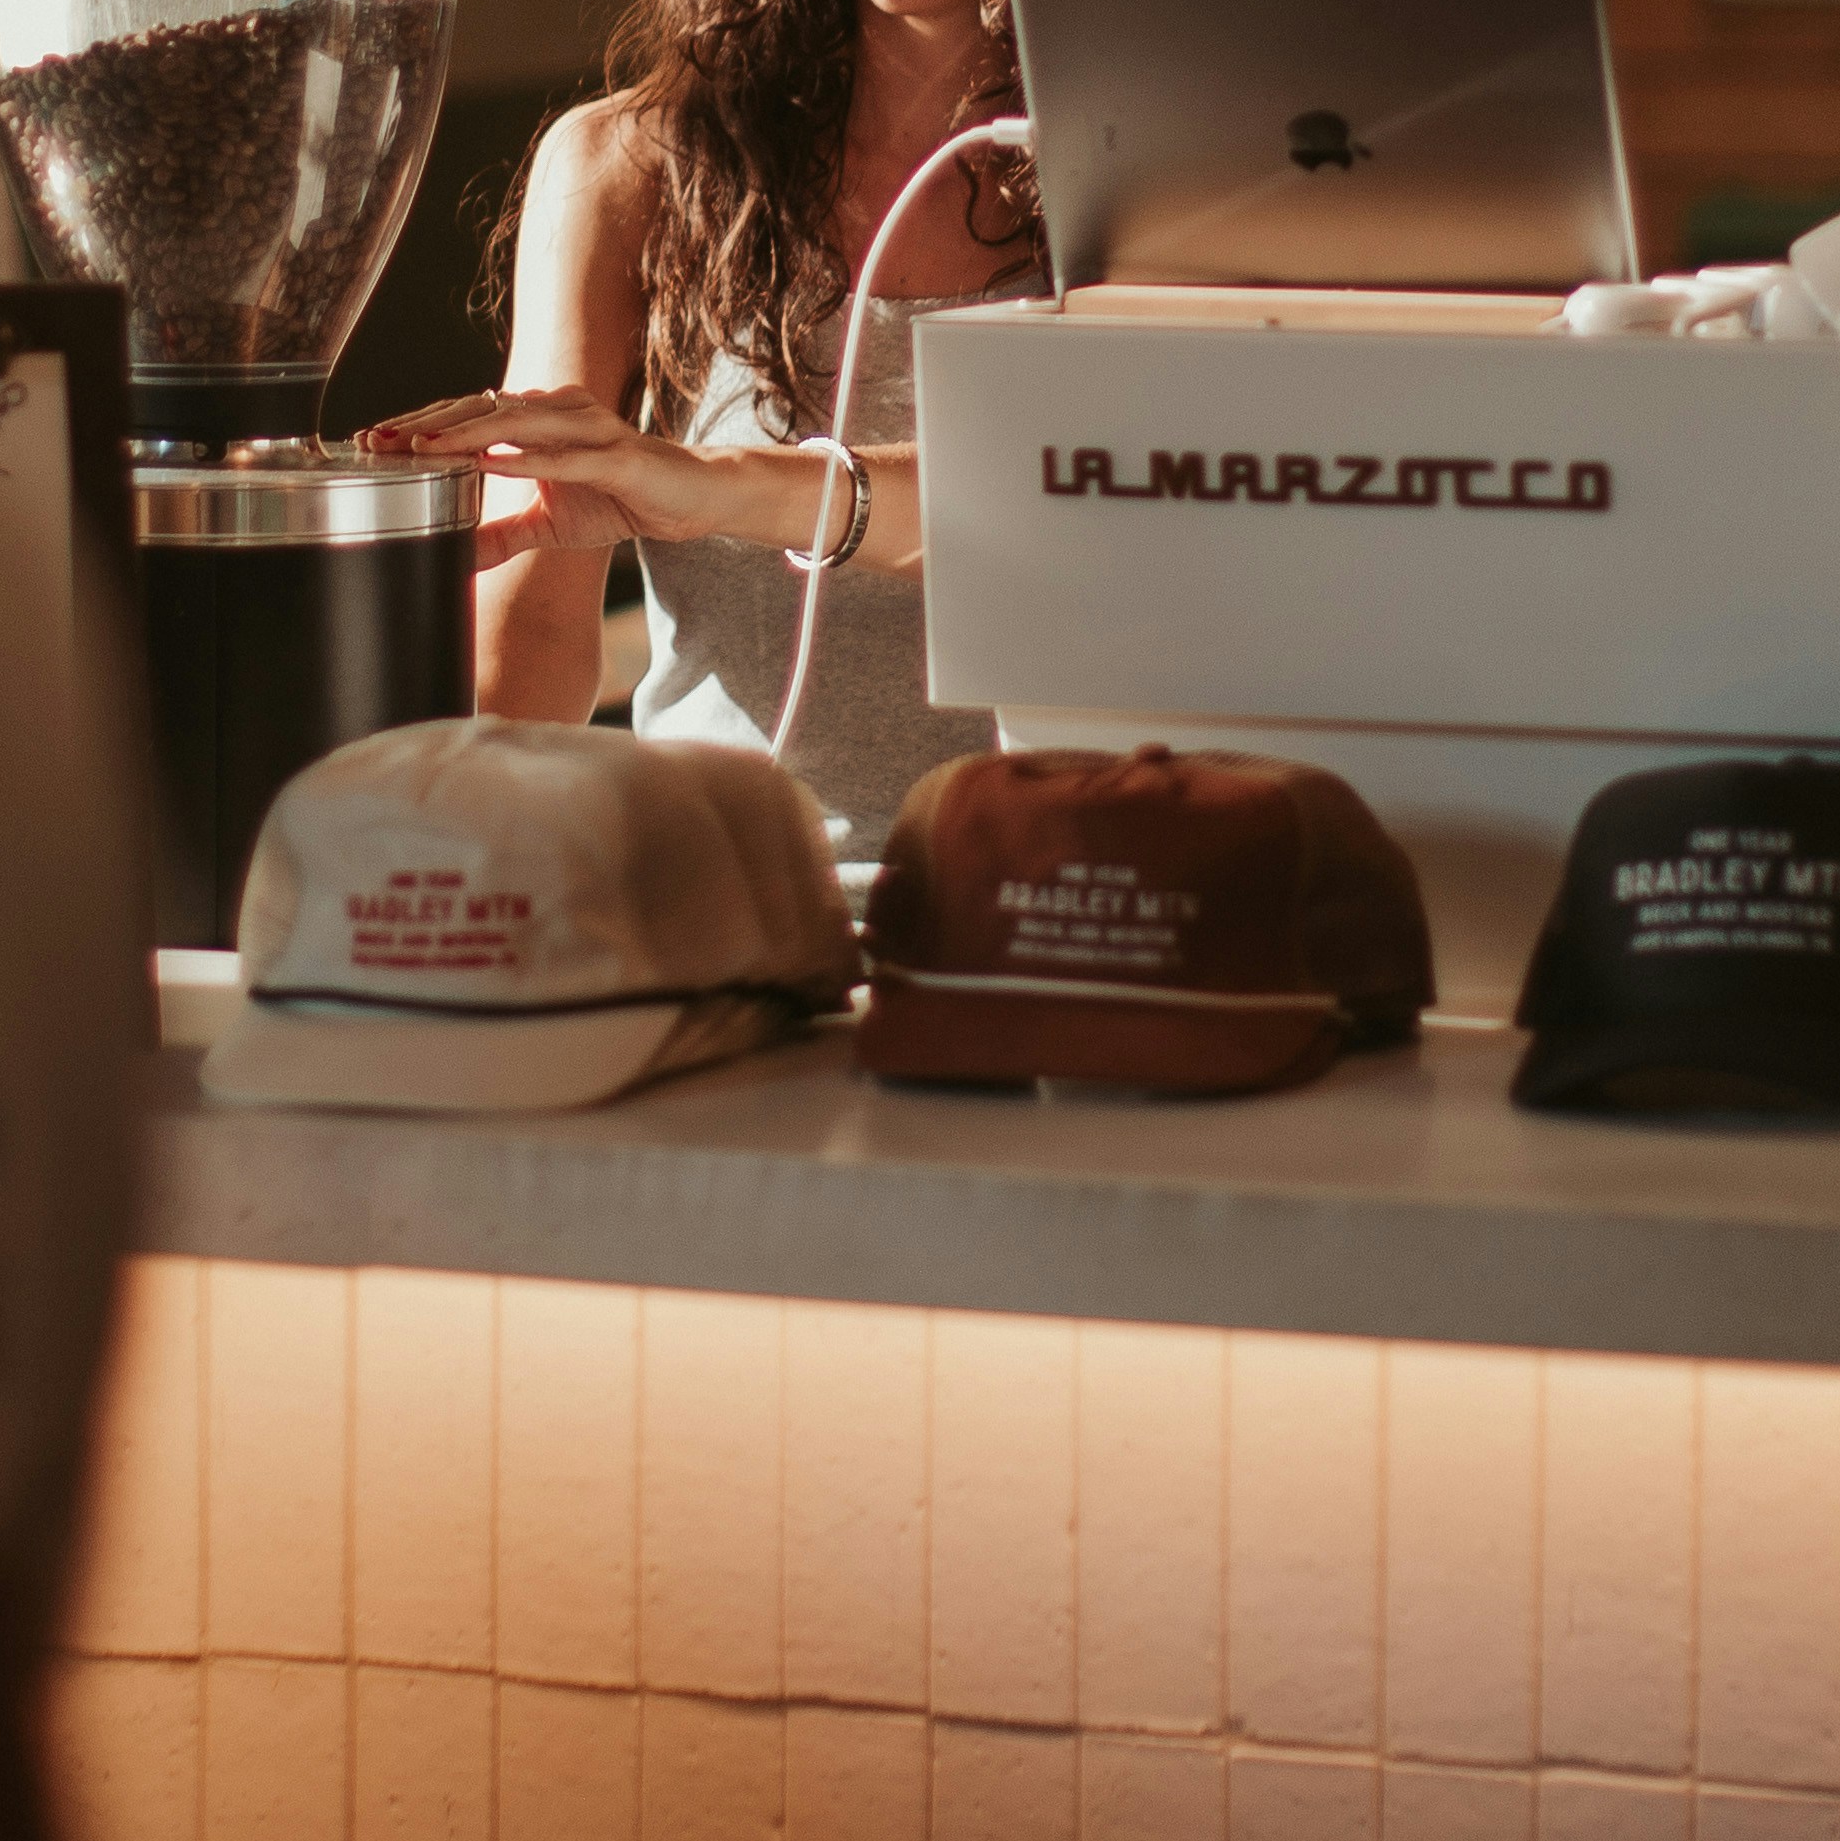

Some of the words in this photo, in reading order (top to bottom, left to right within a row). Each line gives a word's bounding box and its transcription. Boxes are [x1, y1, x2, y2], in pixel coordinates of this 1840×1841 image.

[1043, 446, 1112, 498] LA
[1149, 450, 1613, 512] MARZOCCO
[996, 879, 1126, 919] BRADLEY
[1614, 857, 1771, 902] BRADLEY
